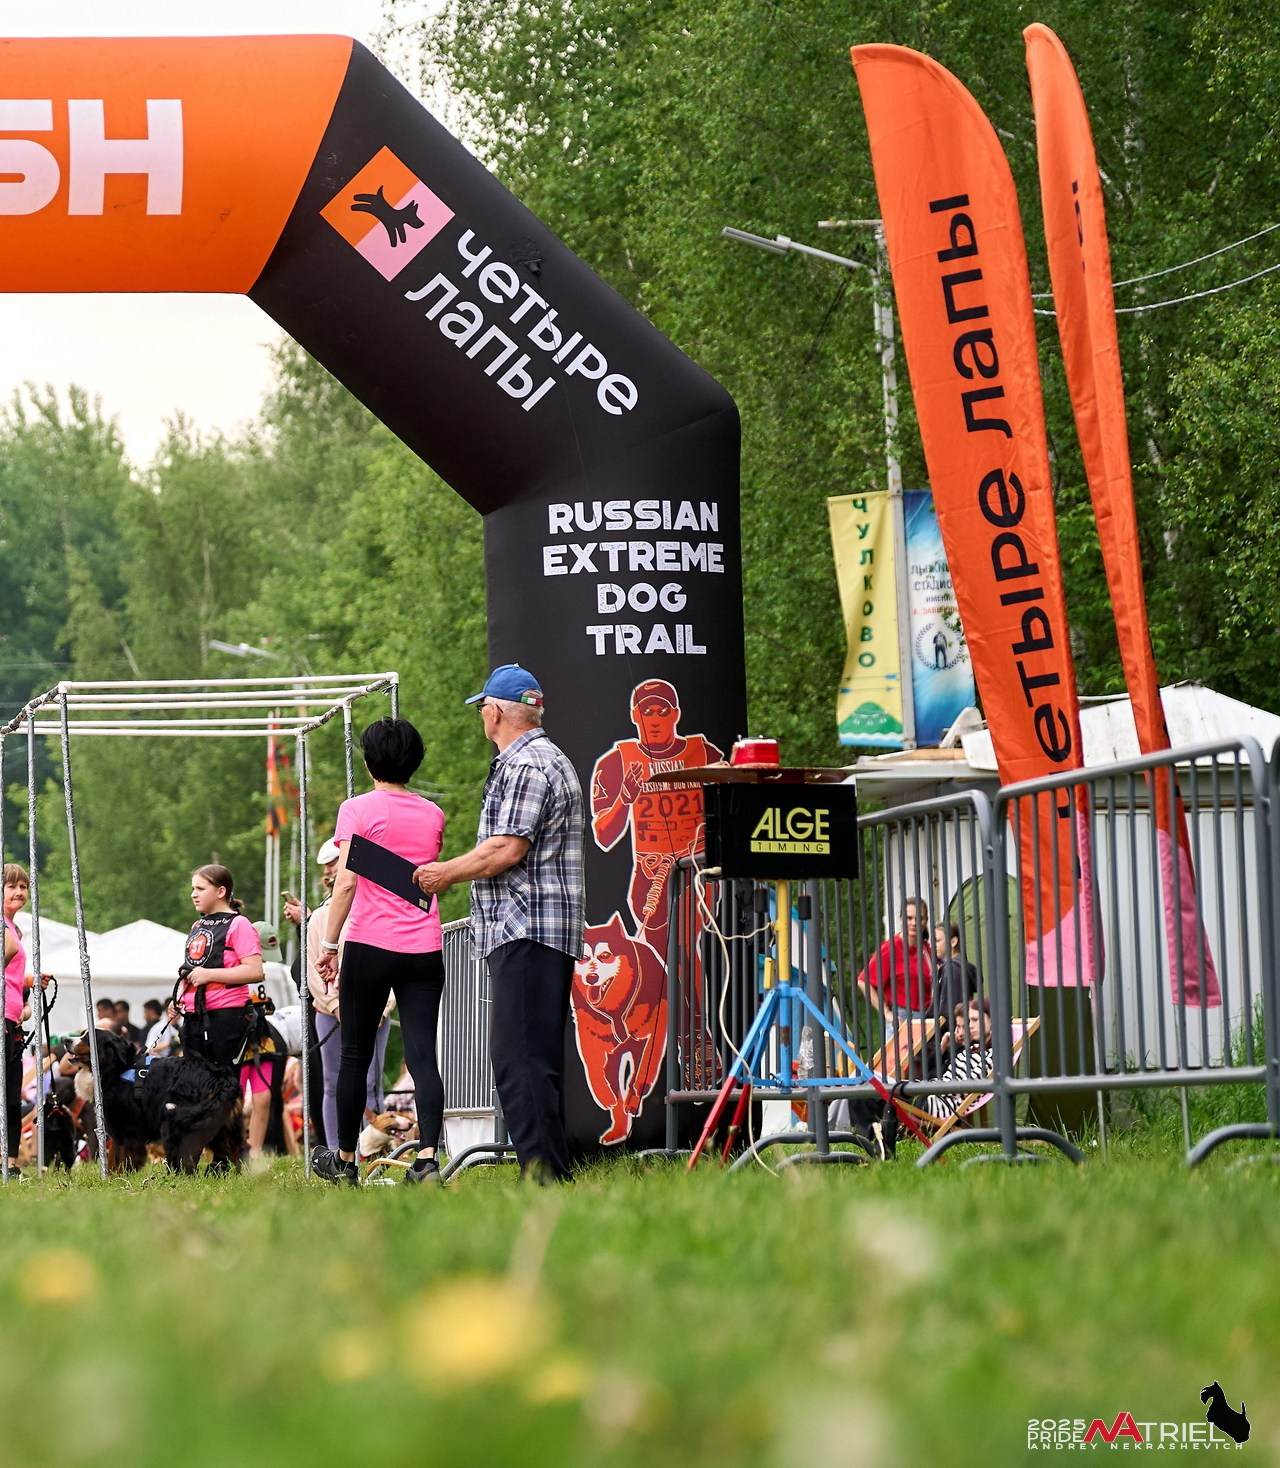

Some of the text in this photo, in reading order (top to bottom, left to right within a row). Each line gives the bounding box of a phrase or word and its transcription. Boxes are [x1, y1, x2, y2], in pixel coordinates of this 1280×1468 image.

[457, 229, 639, 415] четыре
[929, 194, 1013, 438] лапы
[404, 273, 557, 412] лапы
[548, 500, 719, 534] RUSSIAN
[543, 541, 725, 576] EXTREME
[596, 582, 687, 614] DOG
[852, 497, 876, 668] ЧУЛКОВО
[915, 579, 953, 591] СТАДИО
[586, 623, 707, 655] TRAIL
[639, 793, 704, 818] 2021
[751, 807, 830, 840] ALGE
[758, 842, 824, 853] TIMING
